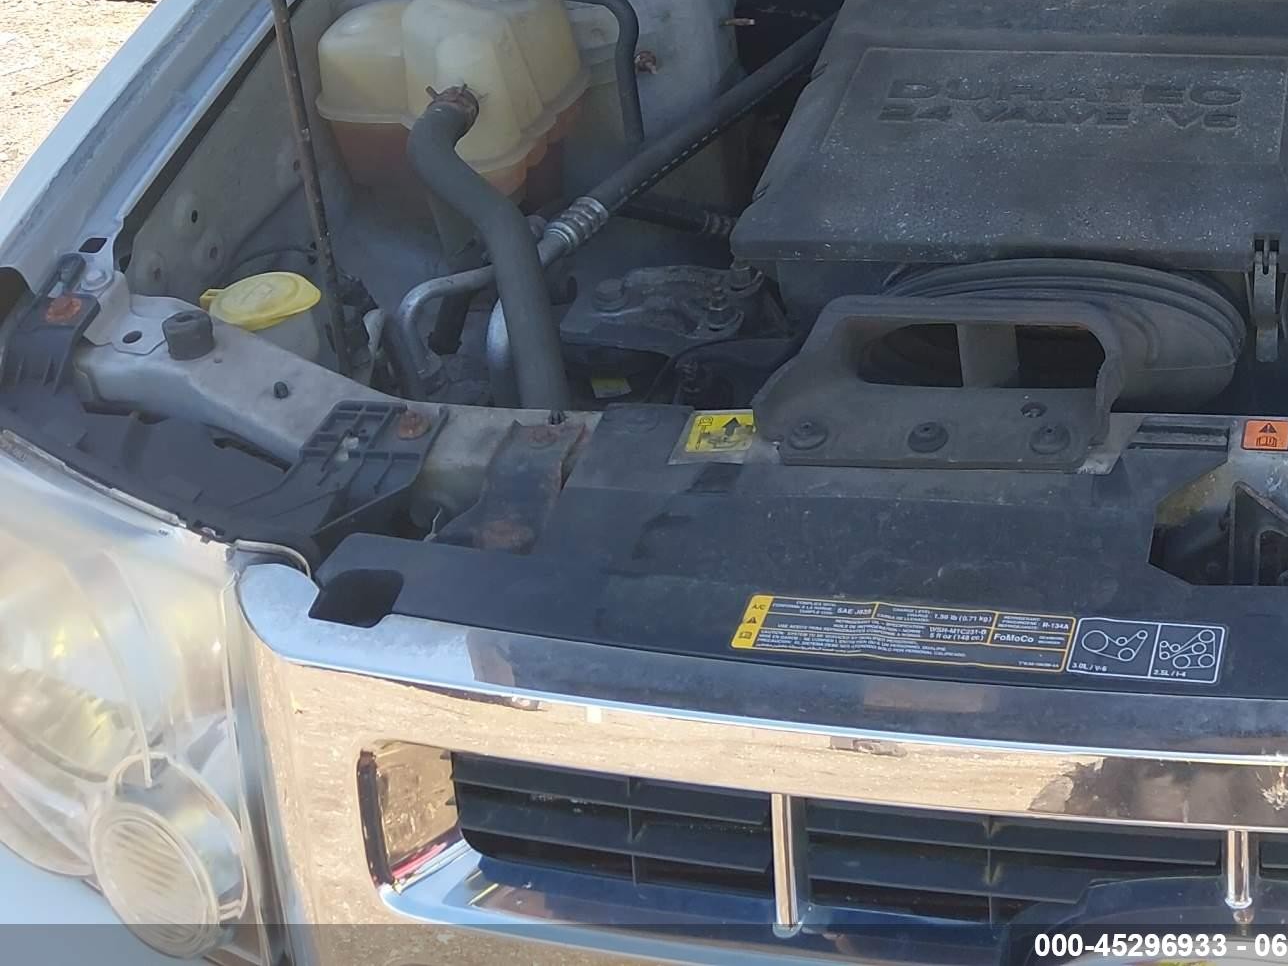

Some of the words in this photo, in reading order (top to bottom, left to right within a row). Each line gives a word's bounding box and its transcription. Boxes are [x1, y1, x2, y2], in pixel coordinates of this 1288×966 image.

[887, 80, 1242, 106] DURATEC
[878, 105, 952, 123] 24
[970, 106, 1130, 129] VALVE
[1166, 109, 1239, 130] V6
[837, 607, 853, 615] SAE
[1041, 622, 1069, 630] R-134A
[993, 633, 1034, 643] FoMoCo
[1072, 662, 1088, 670] 3.0L
[1094, 664, 1107, 672] V-6
